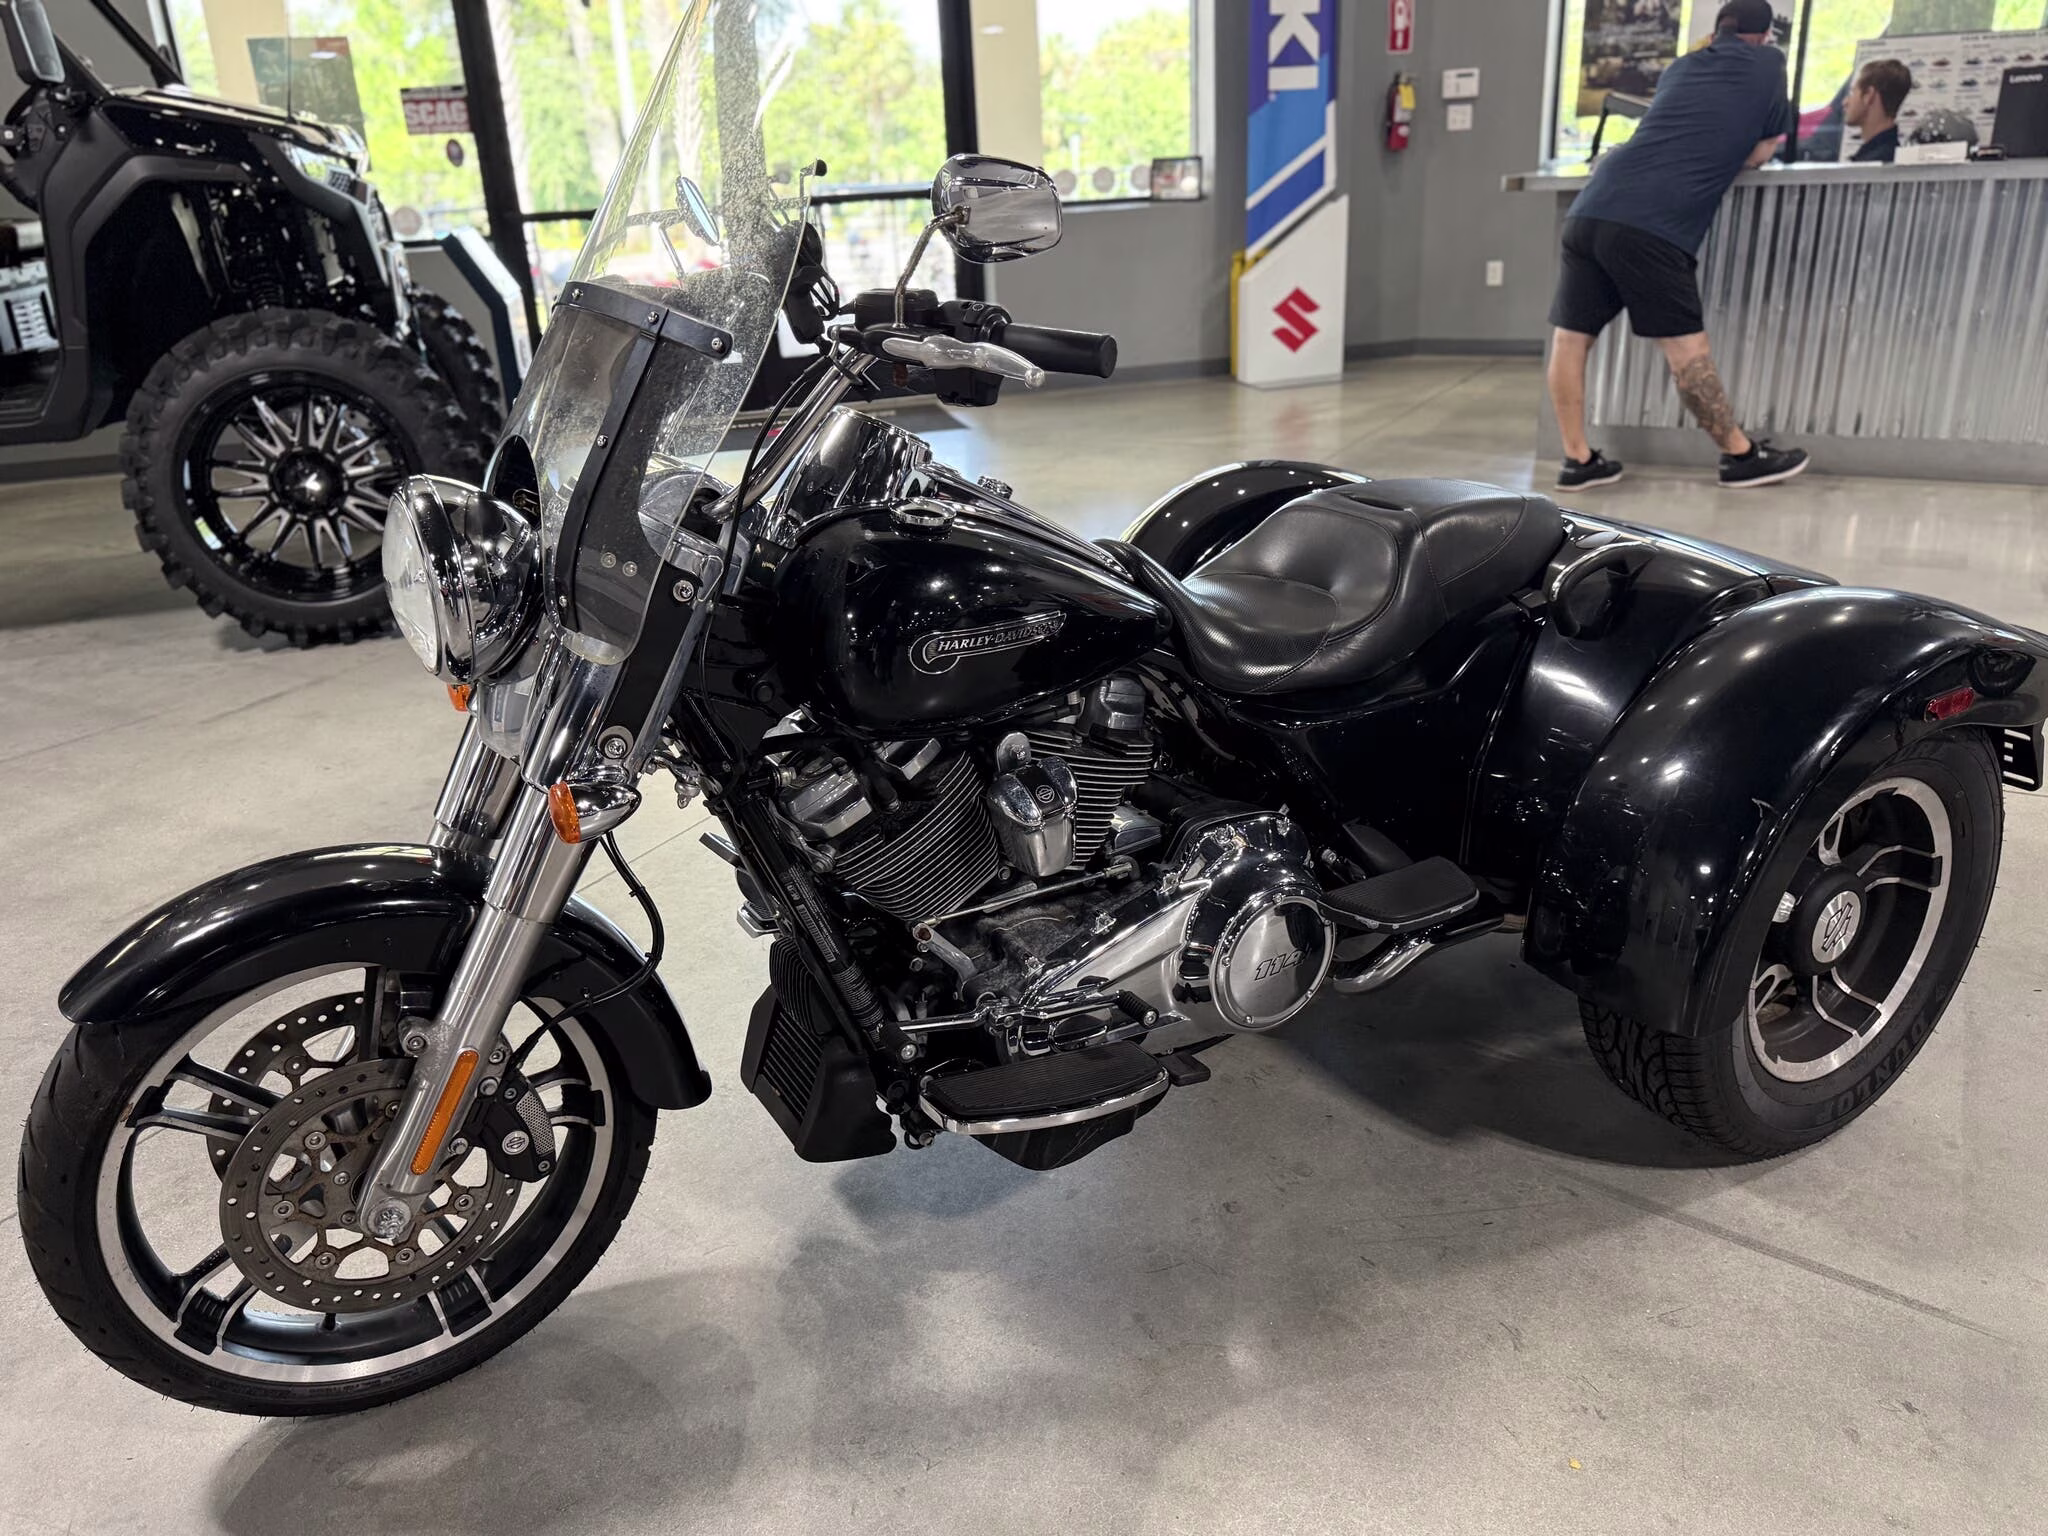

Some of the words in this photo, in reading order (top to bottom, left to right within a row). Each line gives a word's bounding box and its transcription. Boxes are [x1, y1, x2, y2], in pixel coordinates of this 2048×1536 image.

[2008, 73, 2044, 84] Lenovo
[404, 100, 468, 126] SCAG
[1255, 951, 1305, 981] 114
